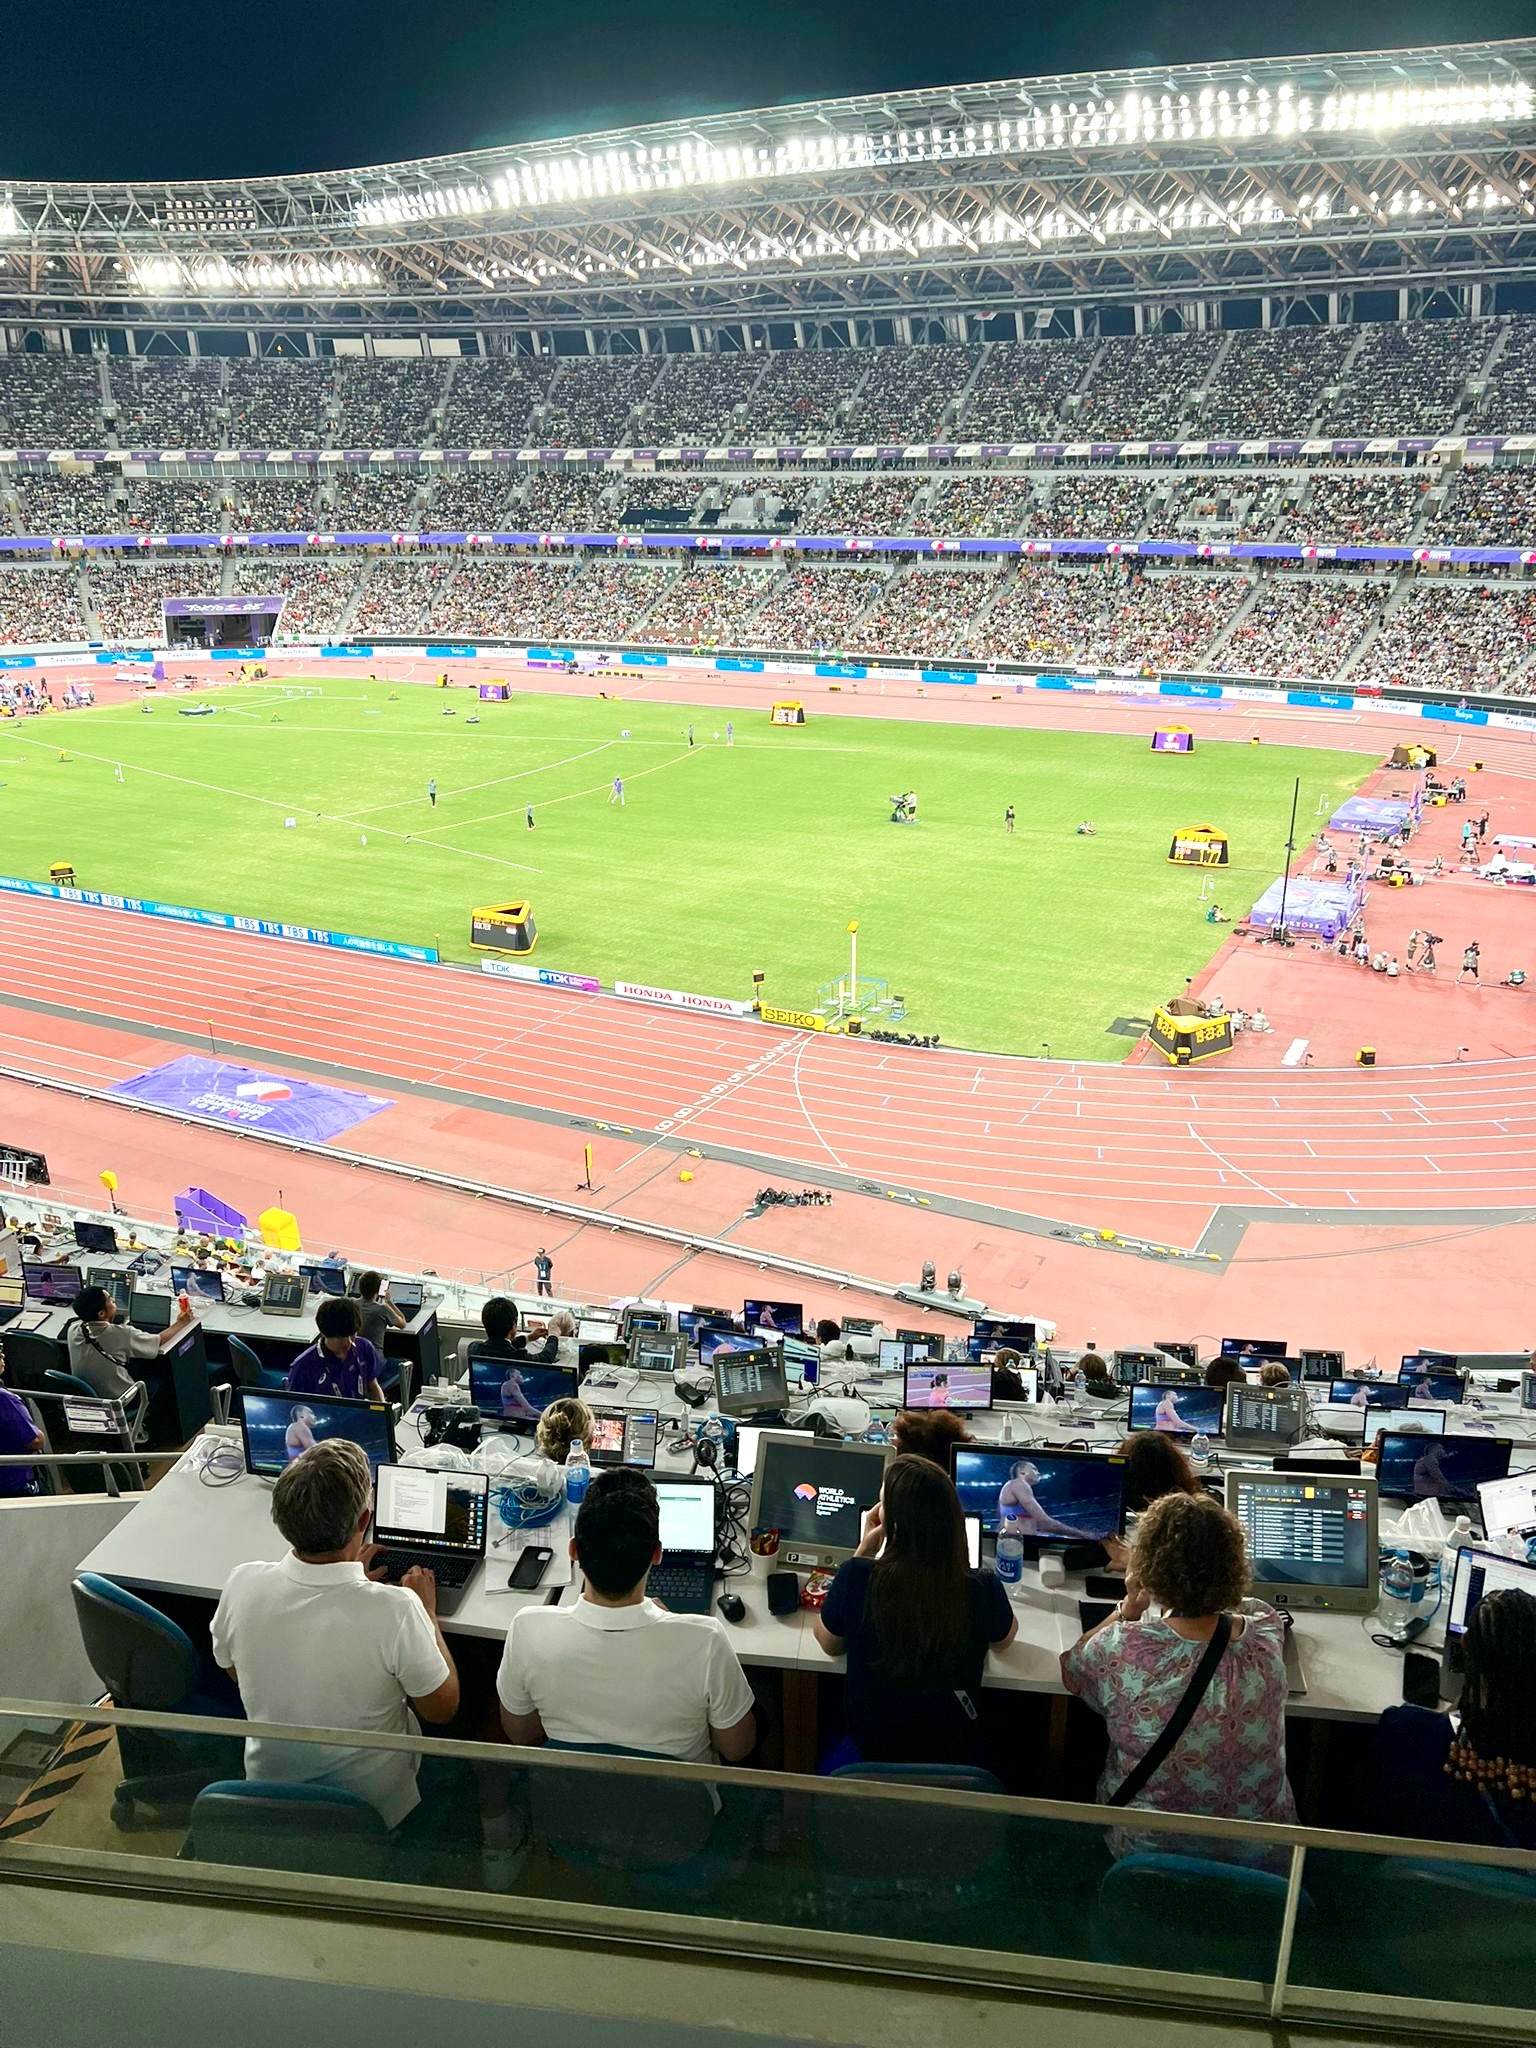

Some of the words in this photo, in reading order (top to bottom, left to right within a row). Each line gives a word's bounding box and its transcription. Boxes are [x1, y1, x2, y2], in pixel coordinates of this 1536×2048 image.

[63, 889, 78, 899] TBS
[84, 893, 100, 904] TBS
[105, 896, 121, 907] TBS
[127, 899, 143, 911] TBS
[239, 918, 255, 930] TBS
[262, 922, 279, 935] TBS
[287, 926, 303, 938] TBS
[311, 930, 329, 943] TBS
[490, 963, 510, 973] TDK
[547, 972, 569, 984] TDK
[623, 985, 673, 1001] HONDA
[682, 995, 733, 1011] HONDA
[764, 1008, 816, 1027] SEIKO
[774, 1041, 792, 1051] 2
[759, 1051, 777, 1061] 3
[744, 1062, 761, 1072] 4
[726, 1072, 747, 1083] 5
[709, 1083, 729, 1094] 6
[692, 1095, 713, 1106] 7
[673, 1107, 693, 1118] 8
[654, 1119, 675, 1131] 9
[819, 1487, 844, 1496] WORLD
[818, 1494, 855, 1505] ATHLETICS
